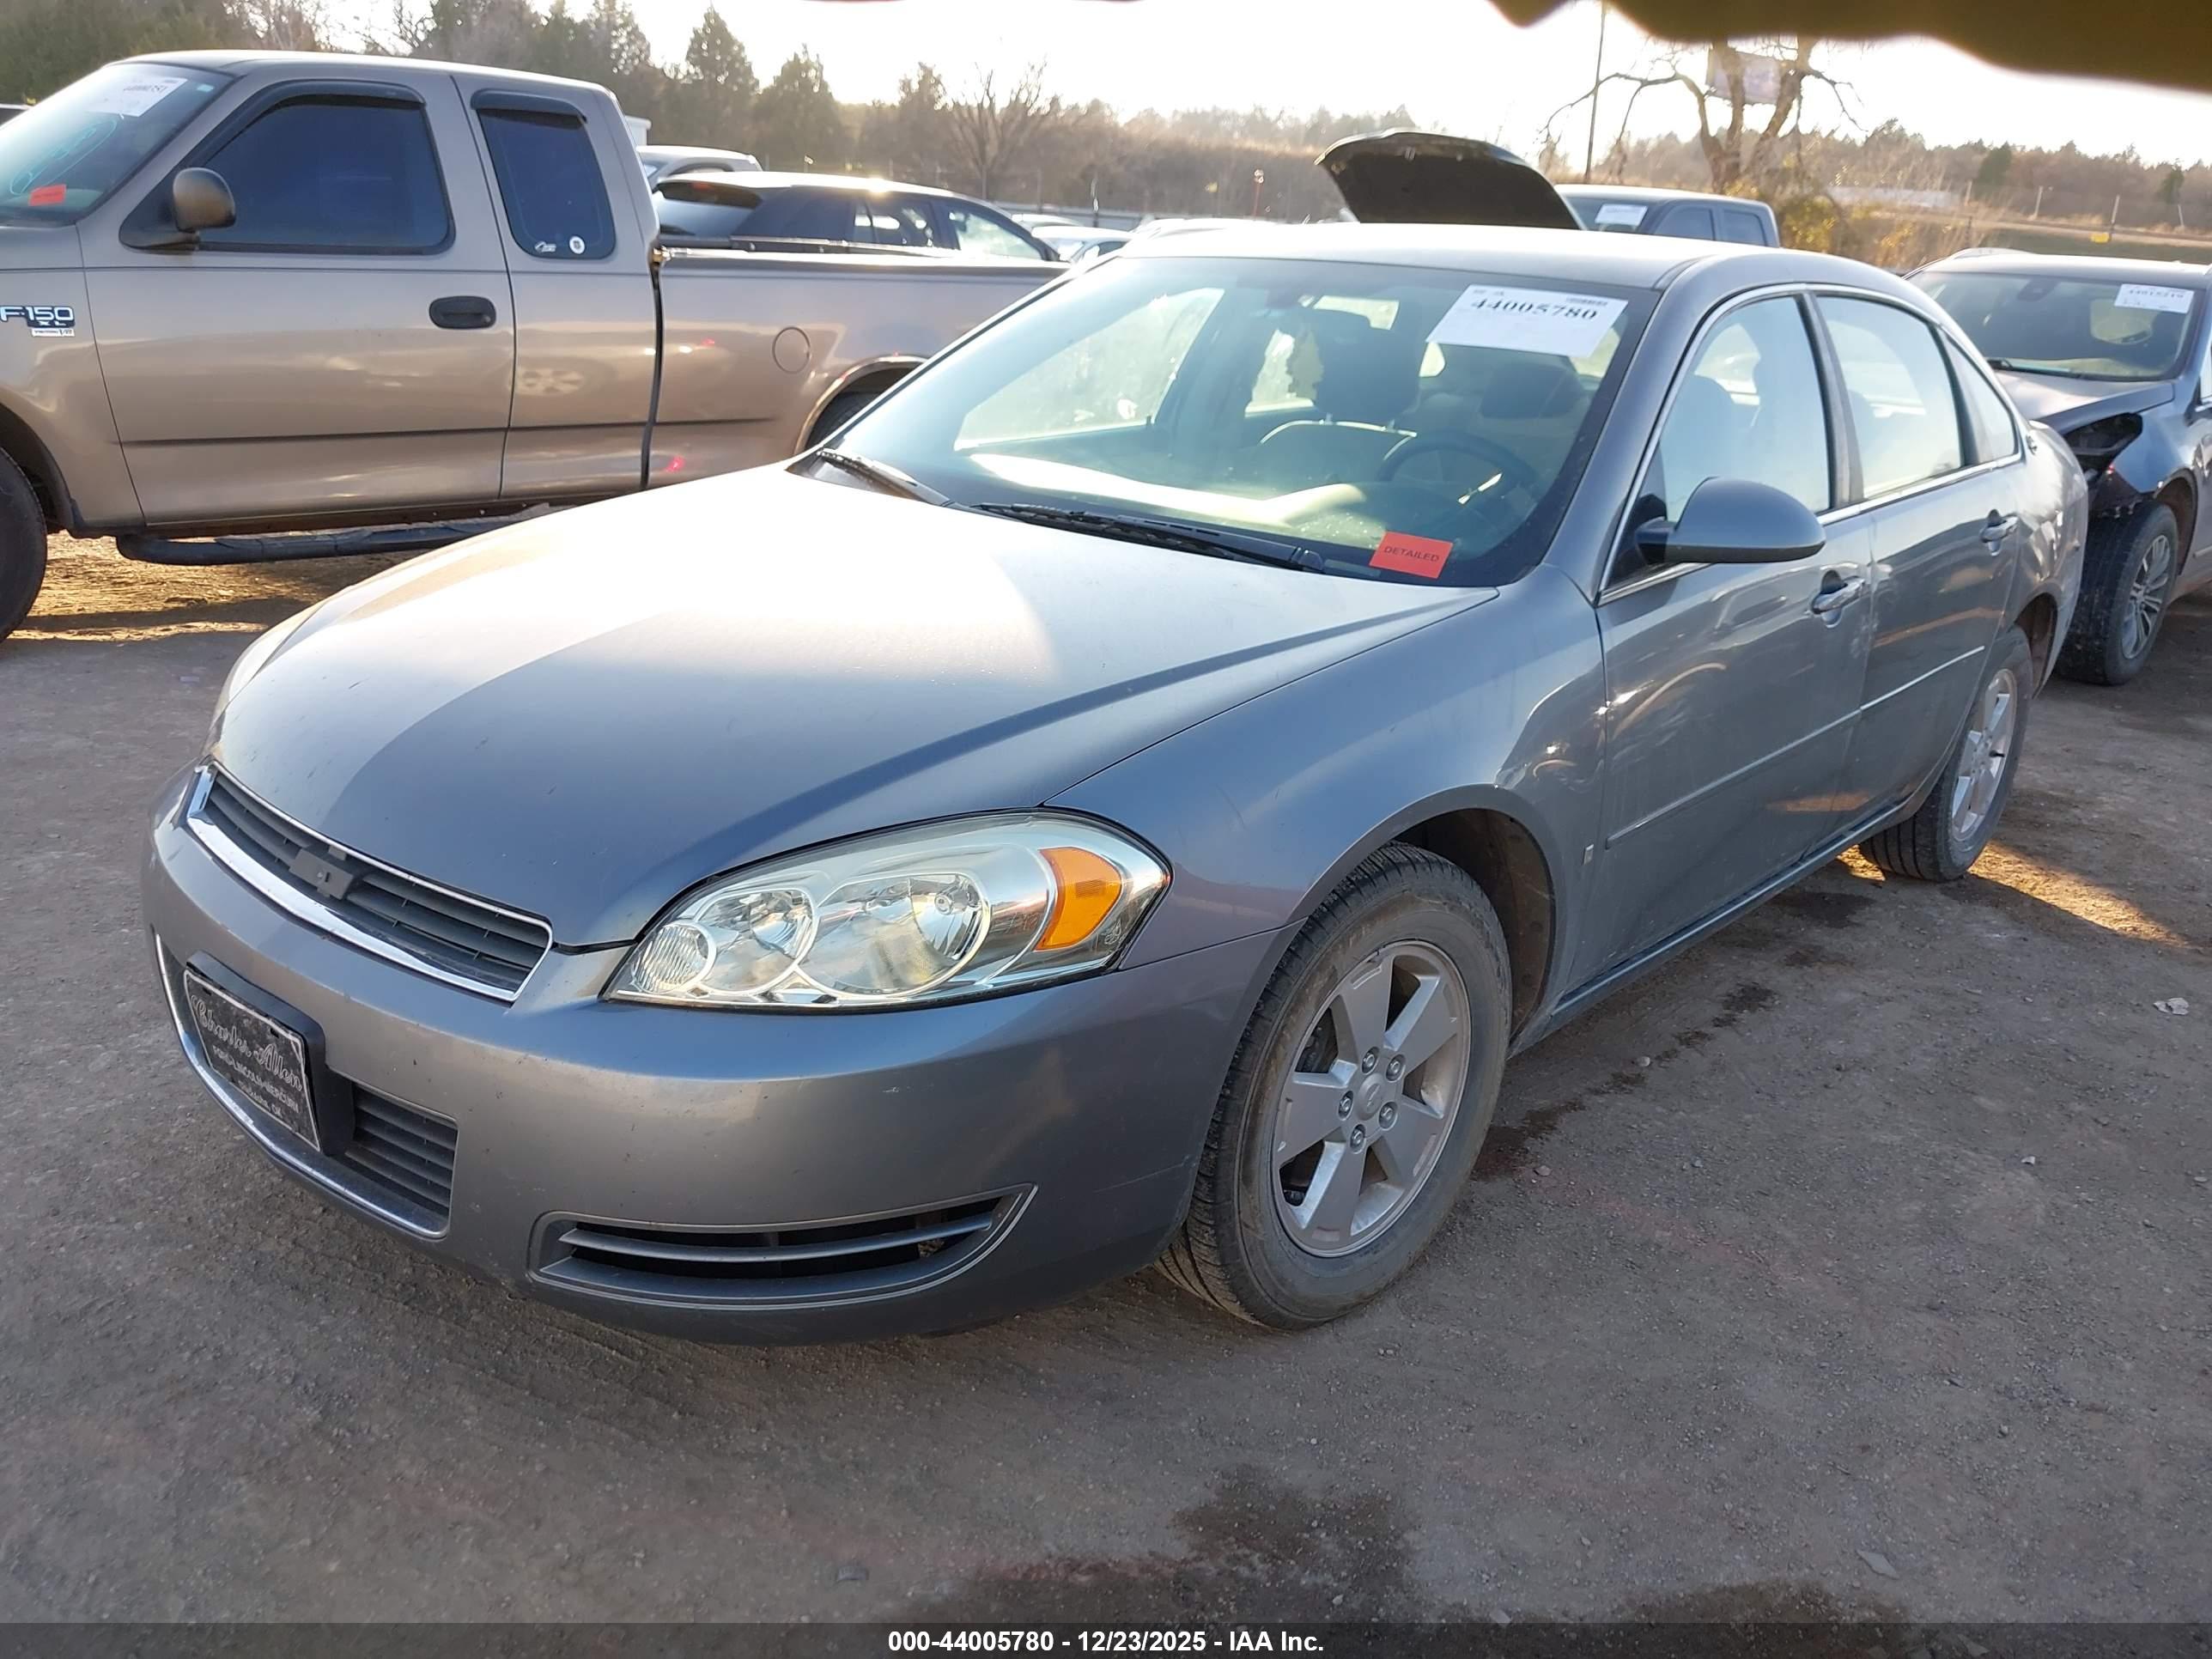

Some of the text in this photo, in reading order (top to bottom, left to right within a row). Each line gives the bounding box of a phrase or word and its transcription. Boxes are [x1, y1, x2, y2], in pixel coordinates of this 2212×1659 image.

[1471, 298, 1599, 320] 44005780
[1383, 545, 1440, 562] DETAILED
[191, 994, 303, 1092] Charles Allen
